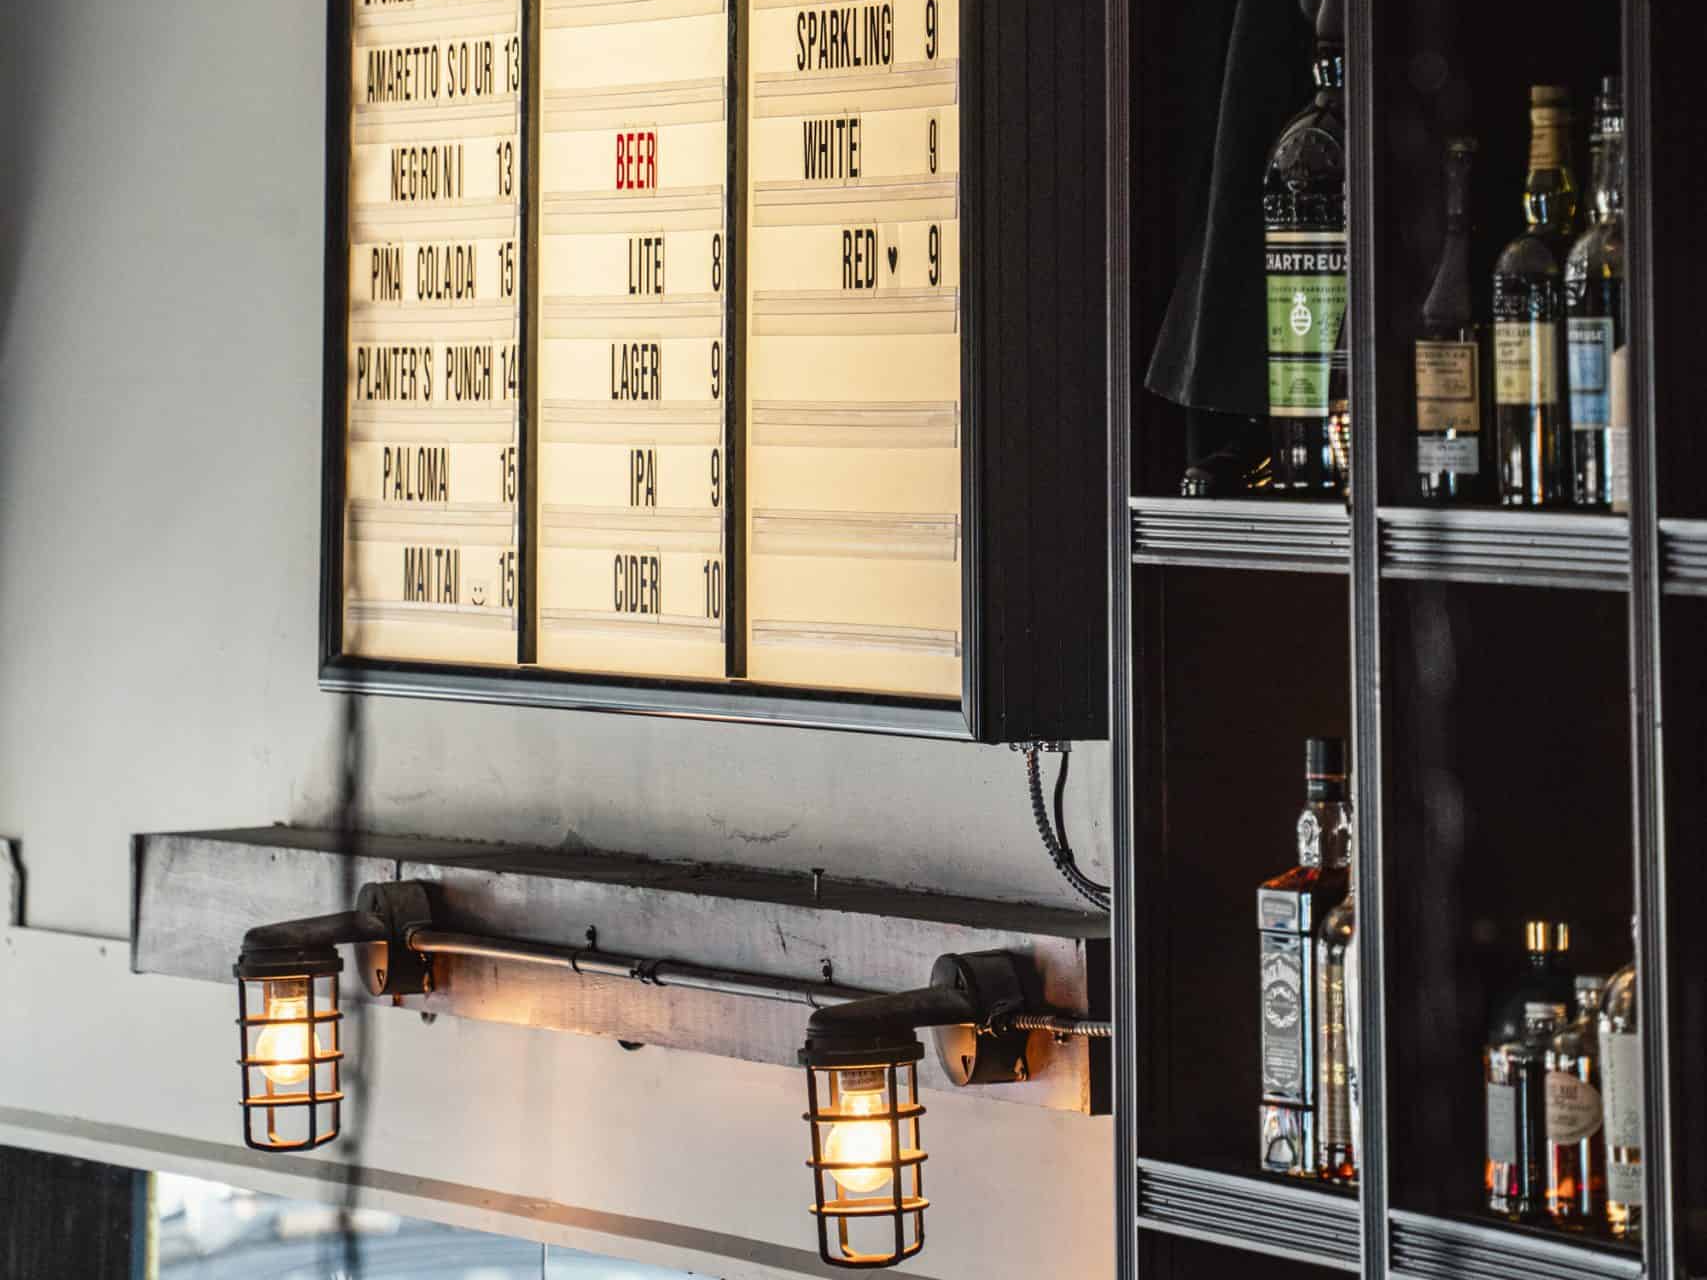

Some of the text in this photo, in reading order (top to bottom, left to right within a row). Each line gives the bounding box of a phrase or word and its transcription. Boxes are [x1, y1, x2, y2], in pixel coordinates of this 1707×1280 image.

[797, 2, 892, 71] SPARKLING
[368, 36, 520, 103] AMARETTO SOUR 13
[391, 142, 513, 201] NEGRONI 13
[616, 131, 656, 190] BEER
[803, 118, 936, 180] WHITE 9
[417, 245, 475, 299] COLADA
[498, 241, 514, 298] 15
[629, 232, 722, 296] LITE 8
[843, 225, 939, 289] RED 9
[446, 346, 492, 401] PUNCH
[501, 344, 517, 400] 14
[611, 340, 722, 401] LAGER 9
[383, 446, 516, 503] PALOMA 15
[630, 448, 722, 507] IPA 9
[499, 551, 516, 608] 15
[614, 553, 722, 619] CIDER 10
